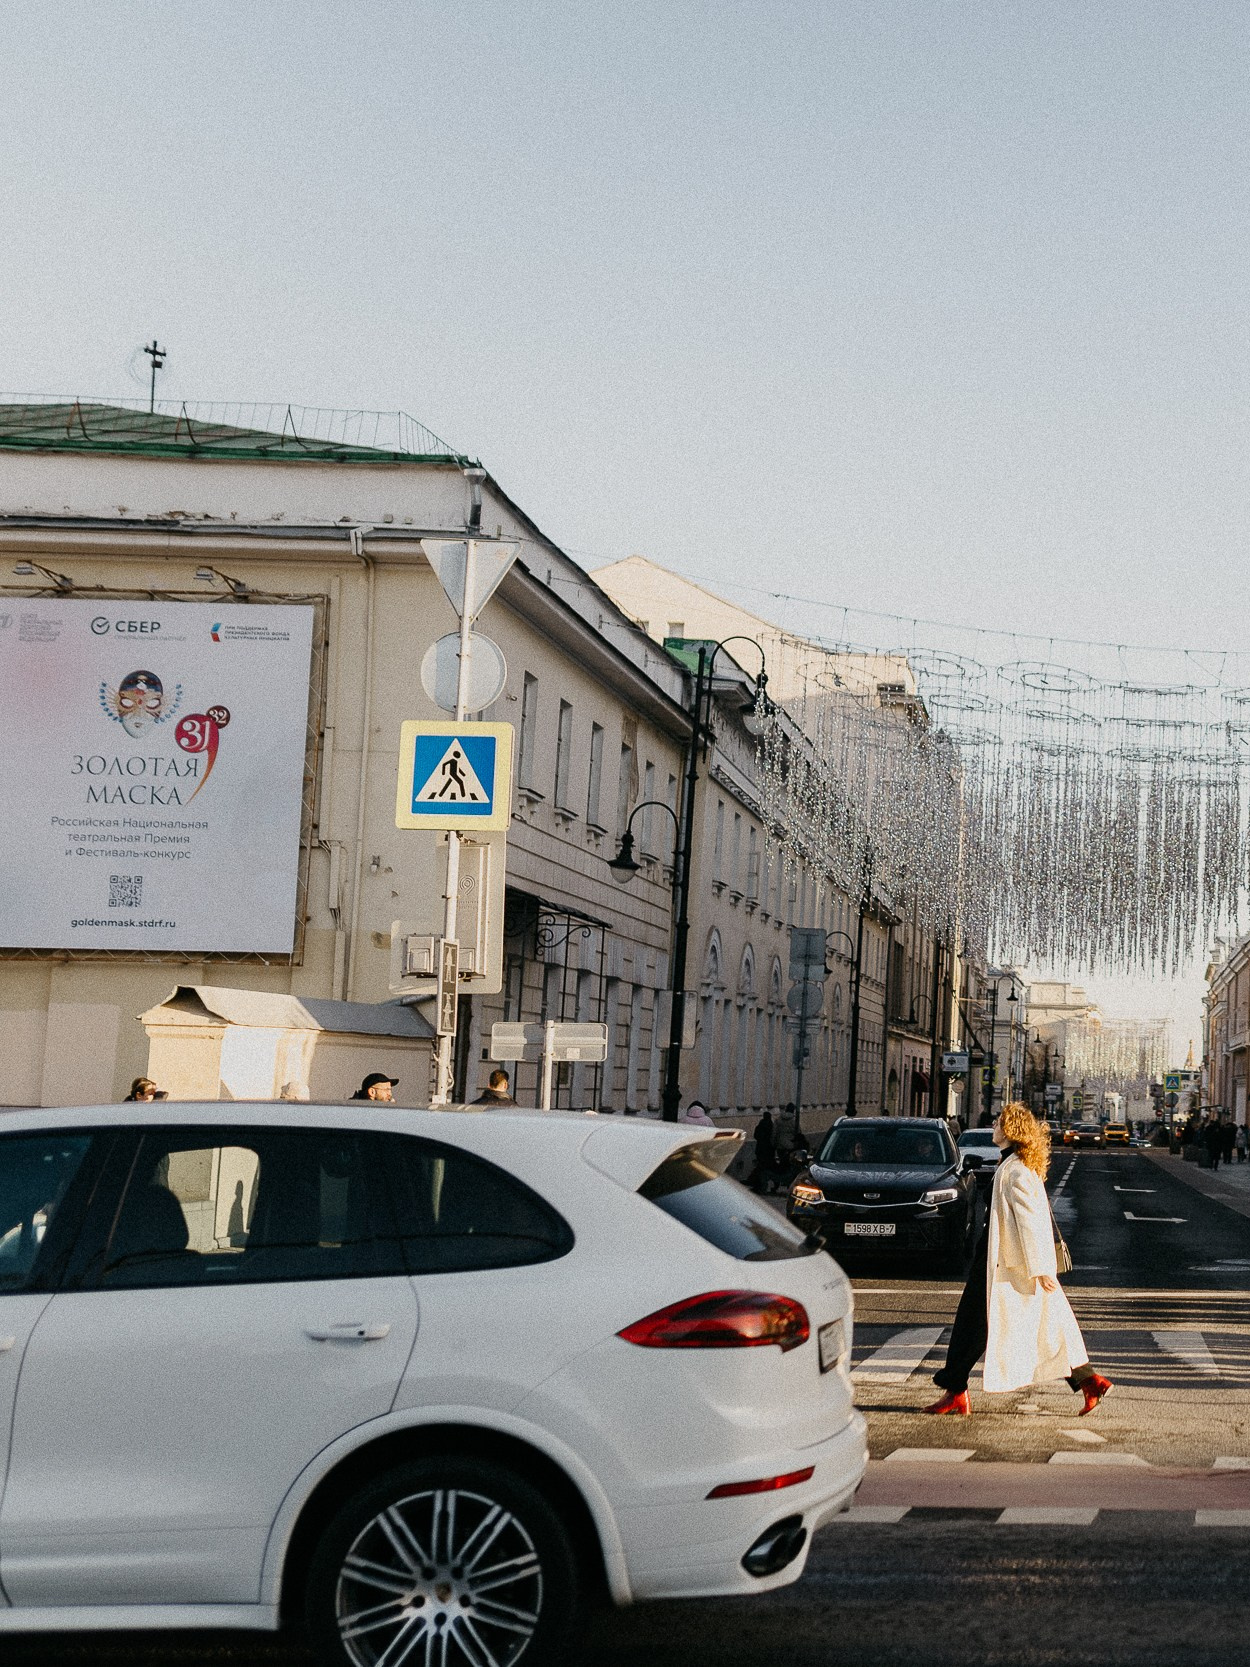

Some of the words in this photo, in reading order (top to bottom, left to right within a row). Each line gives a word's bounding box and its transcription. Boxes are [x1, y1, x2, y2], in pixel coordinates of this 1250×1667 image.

[115, 620, 161, 633] СБЕР
[208, 709, 228, 724] 32
[180, 719, 211, 751] 31
[71, 755, 199, 777] ЗОЛОТАЯ
[86, 784, 183, 806] МАСКА
[51, 816, 119, 827] Российская
[122, 818, 208, 829] Национальная
[68, 833, 141, 843] театральная
[144, 833, 190, 845] Премия
[75, 847, 191, 860] Фестиваль-конкурс
[71, 918, 176, 928] goldenmask.stdrf.ru
[853, 1224, 871, 1233] 1598
